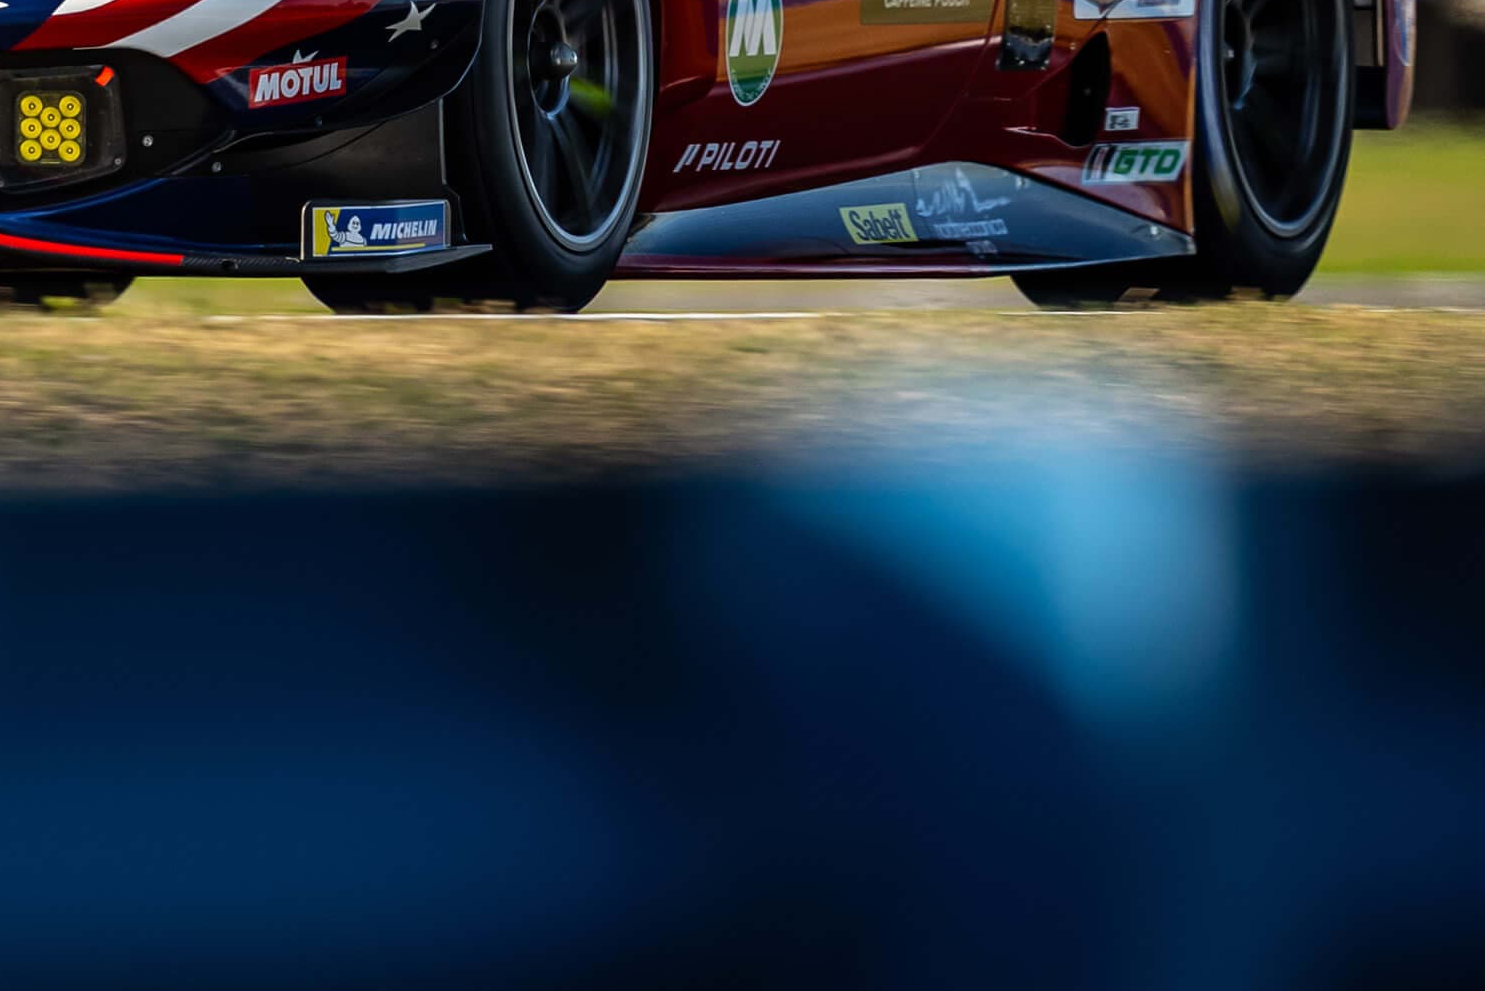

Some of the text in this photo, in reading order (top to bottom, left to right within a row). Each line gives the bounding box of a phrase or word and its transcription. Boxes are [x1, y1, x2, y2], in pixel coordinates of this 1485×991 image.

[254, 63, 343, 101] MOTUL
[696, 140, 781, 172] PILOTI
[1113, 148, 1181, 175] GTO
[370, 219, 437, 241] MICHELIN
[849, 209, 910, 241] Sabelt
